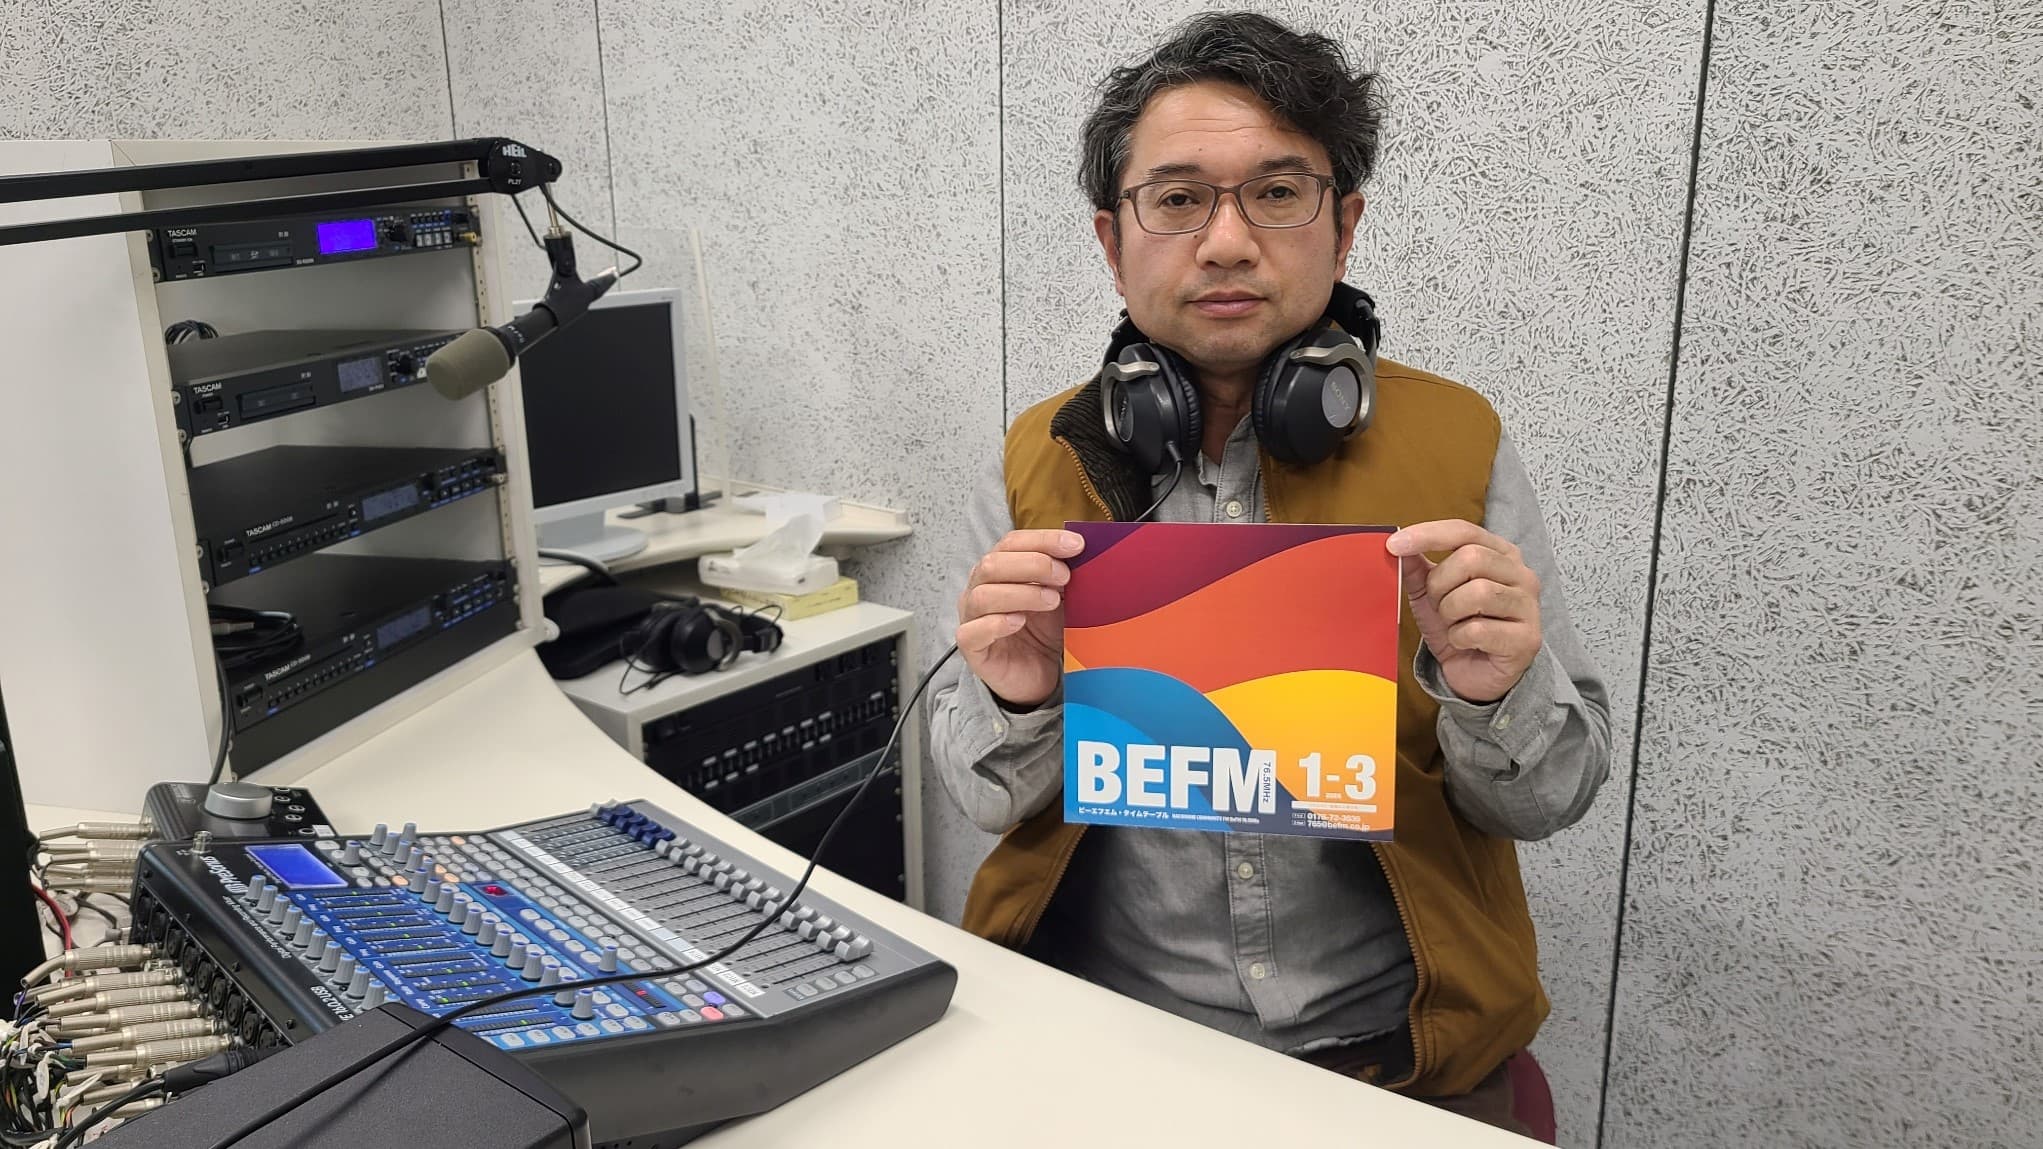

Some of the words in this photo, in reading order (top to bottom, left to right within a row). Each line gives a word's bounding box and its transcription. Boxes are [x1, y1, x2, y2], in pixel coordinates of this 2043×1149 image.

[502, 143, 527, 158] HEIL
[167, 228, 197, 238] TASCAM
[193, 382, 222, 394] TASCAM
[246, 522, 272, 538] TASCAM
[264, 663, 290, 681] TASCAM
[1077, 740, 1277, 814] BEFM
[1262, 761, 1272, 804] 76.5MHz
[1298, 752, 1377, 800] 1-3
